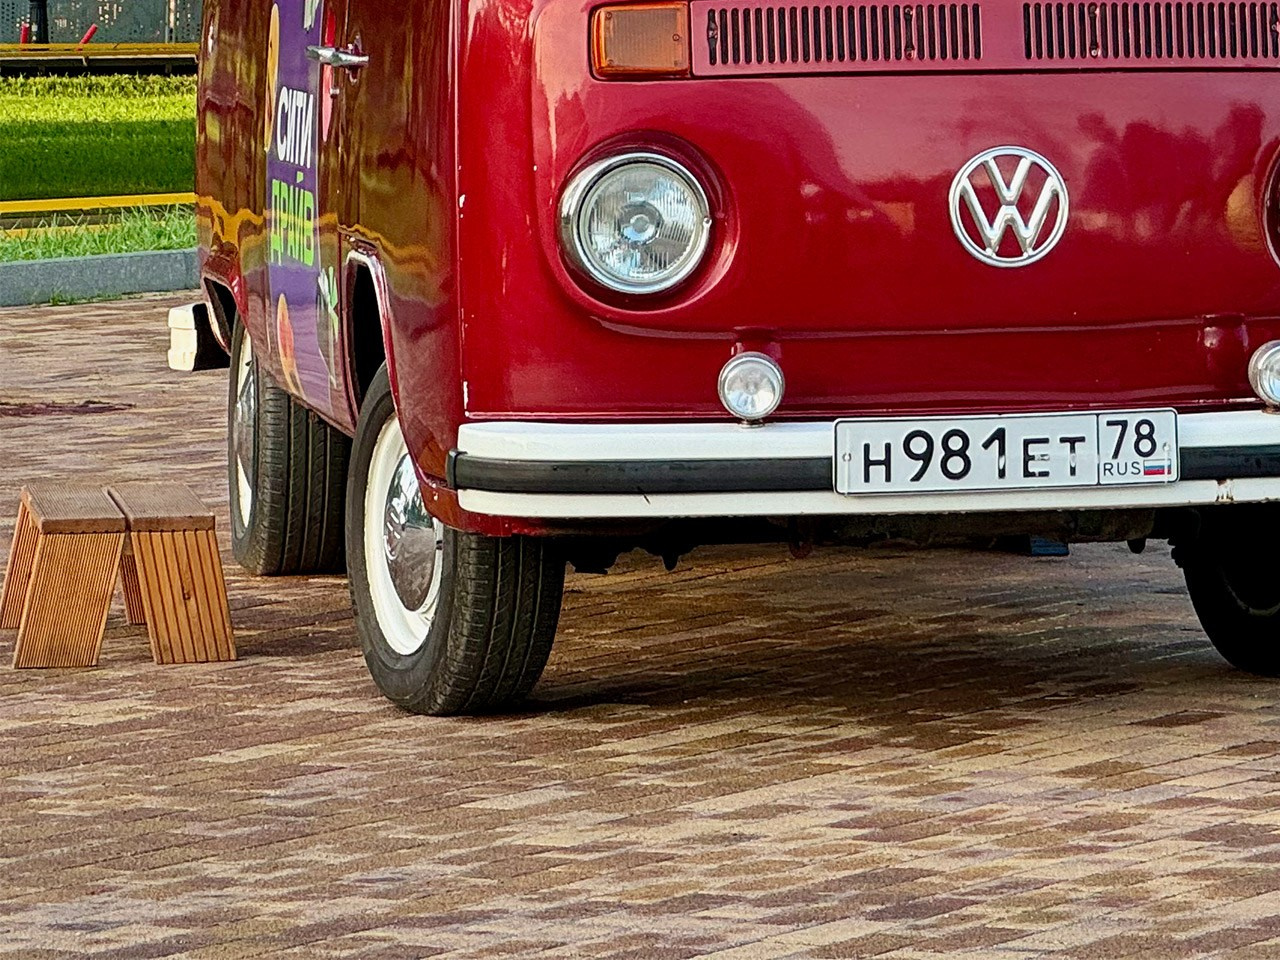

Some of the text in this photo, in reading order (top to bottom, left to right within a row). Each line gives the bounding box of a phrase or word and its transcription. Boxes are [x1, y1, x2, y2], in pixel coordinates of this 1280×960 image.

[277, 86, 314, 169] СИТИ
[271, 171, 314, 267] ДРАЙВ
[1103, 461, 1142, 477] RUS
[1105, 418, 1158, 460] 78
